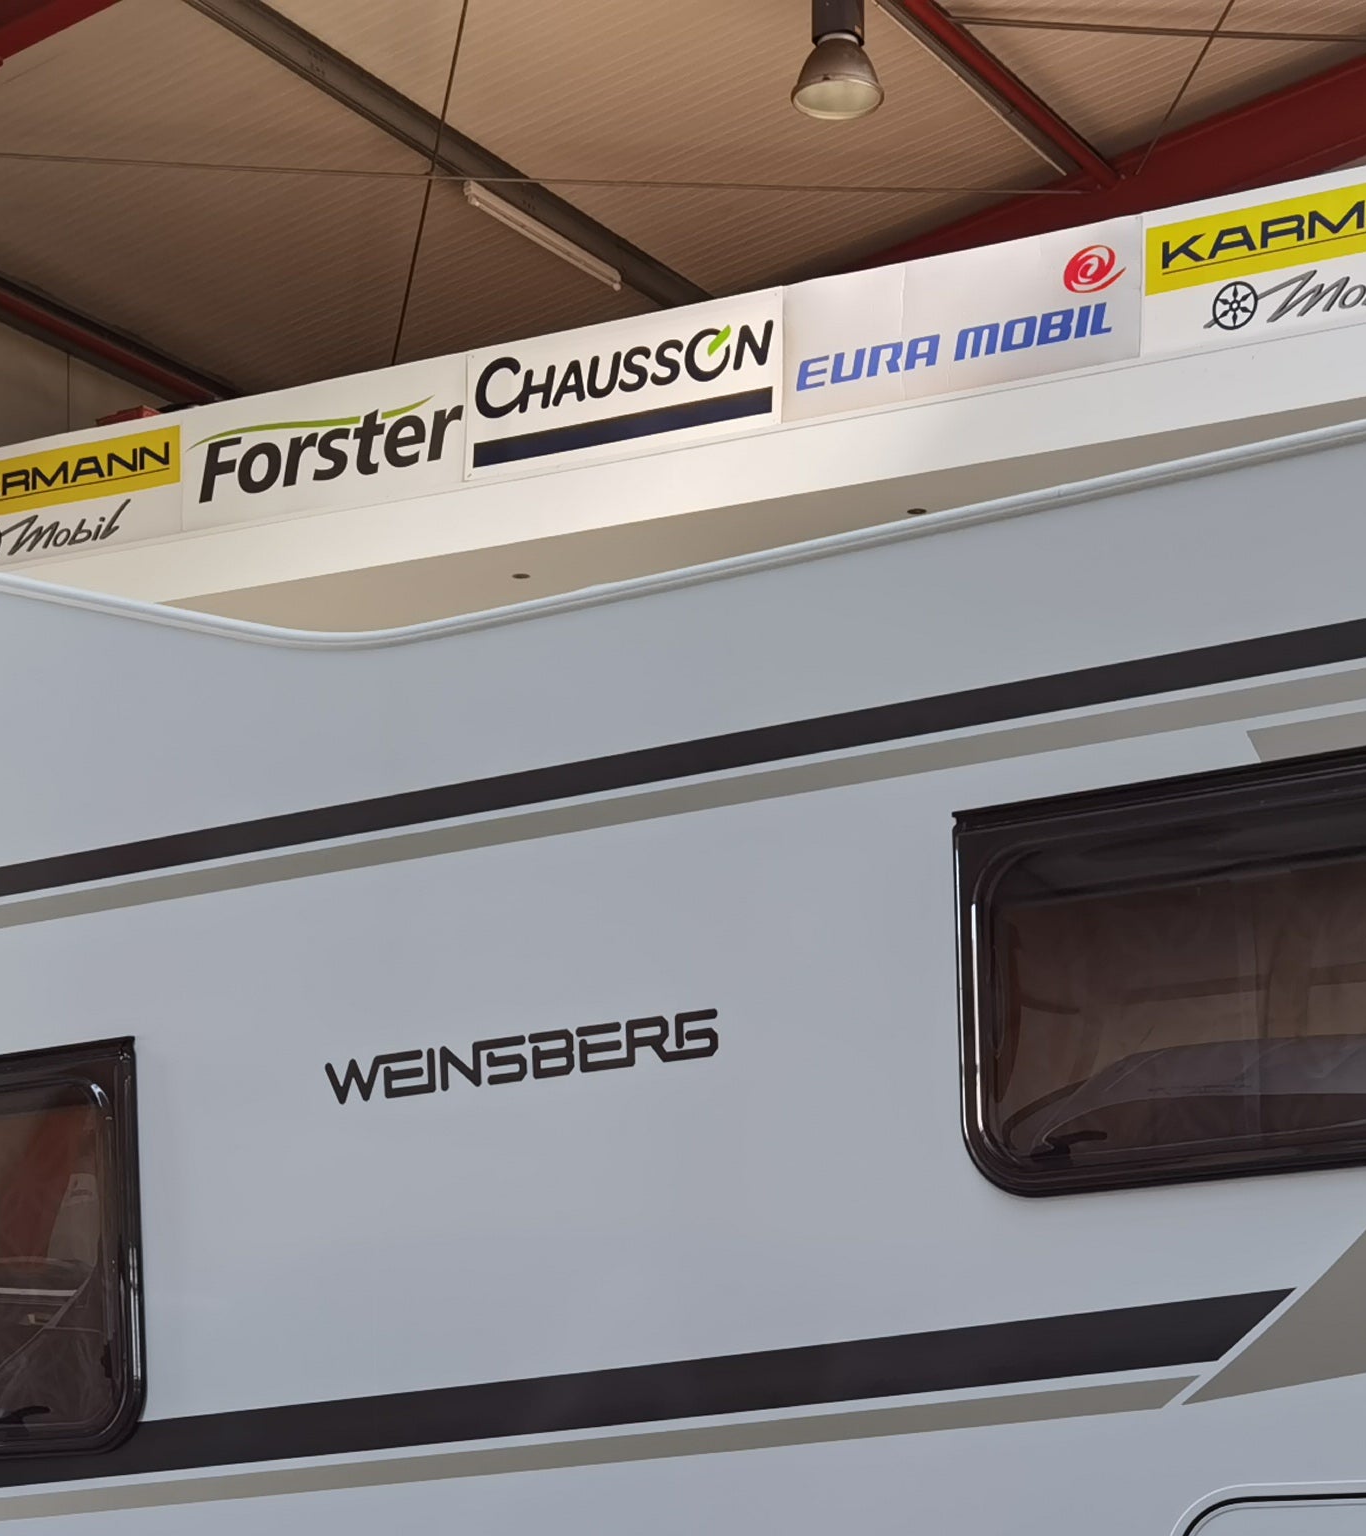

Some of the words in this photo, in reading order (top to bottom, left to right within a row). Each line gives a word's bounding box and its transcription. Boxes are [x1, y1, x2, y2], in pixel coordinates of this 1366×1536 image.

[475, 319, 774, 418] CHAUSSON
[796, 333, 940, 391] EURA
[954, 302, 1112, 361] MOBIL
[198, 404, 464, 504] Forster
[2, 499, 132, 555] Mobil
[324, 1008, 719, 1105] WEINSBERG
